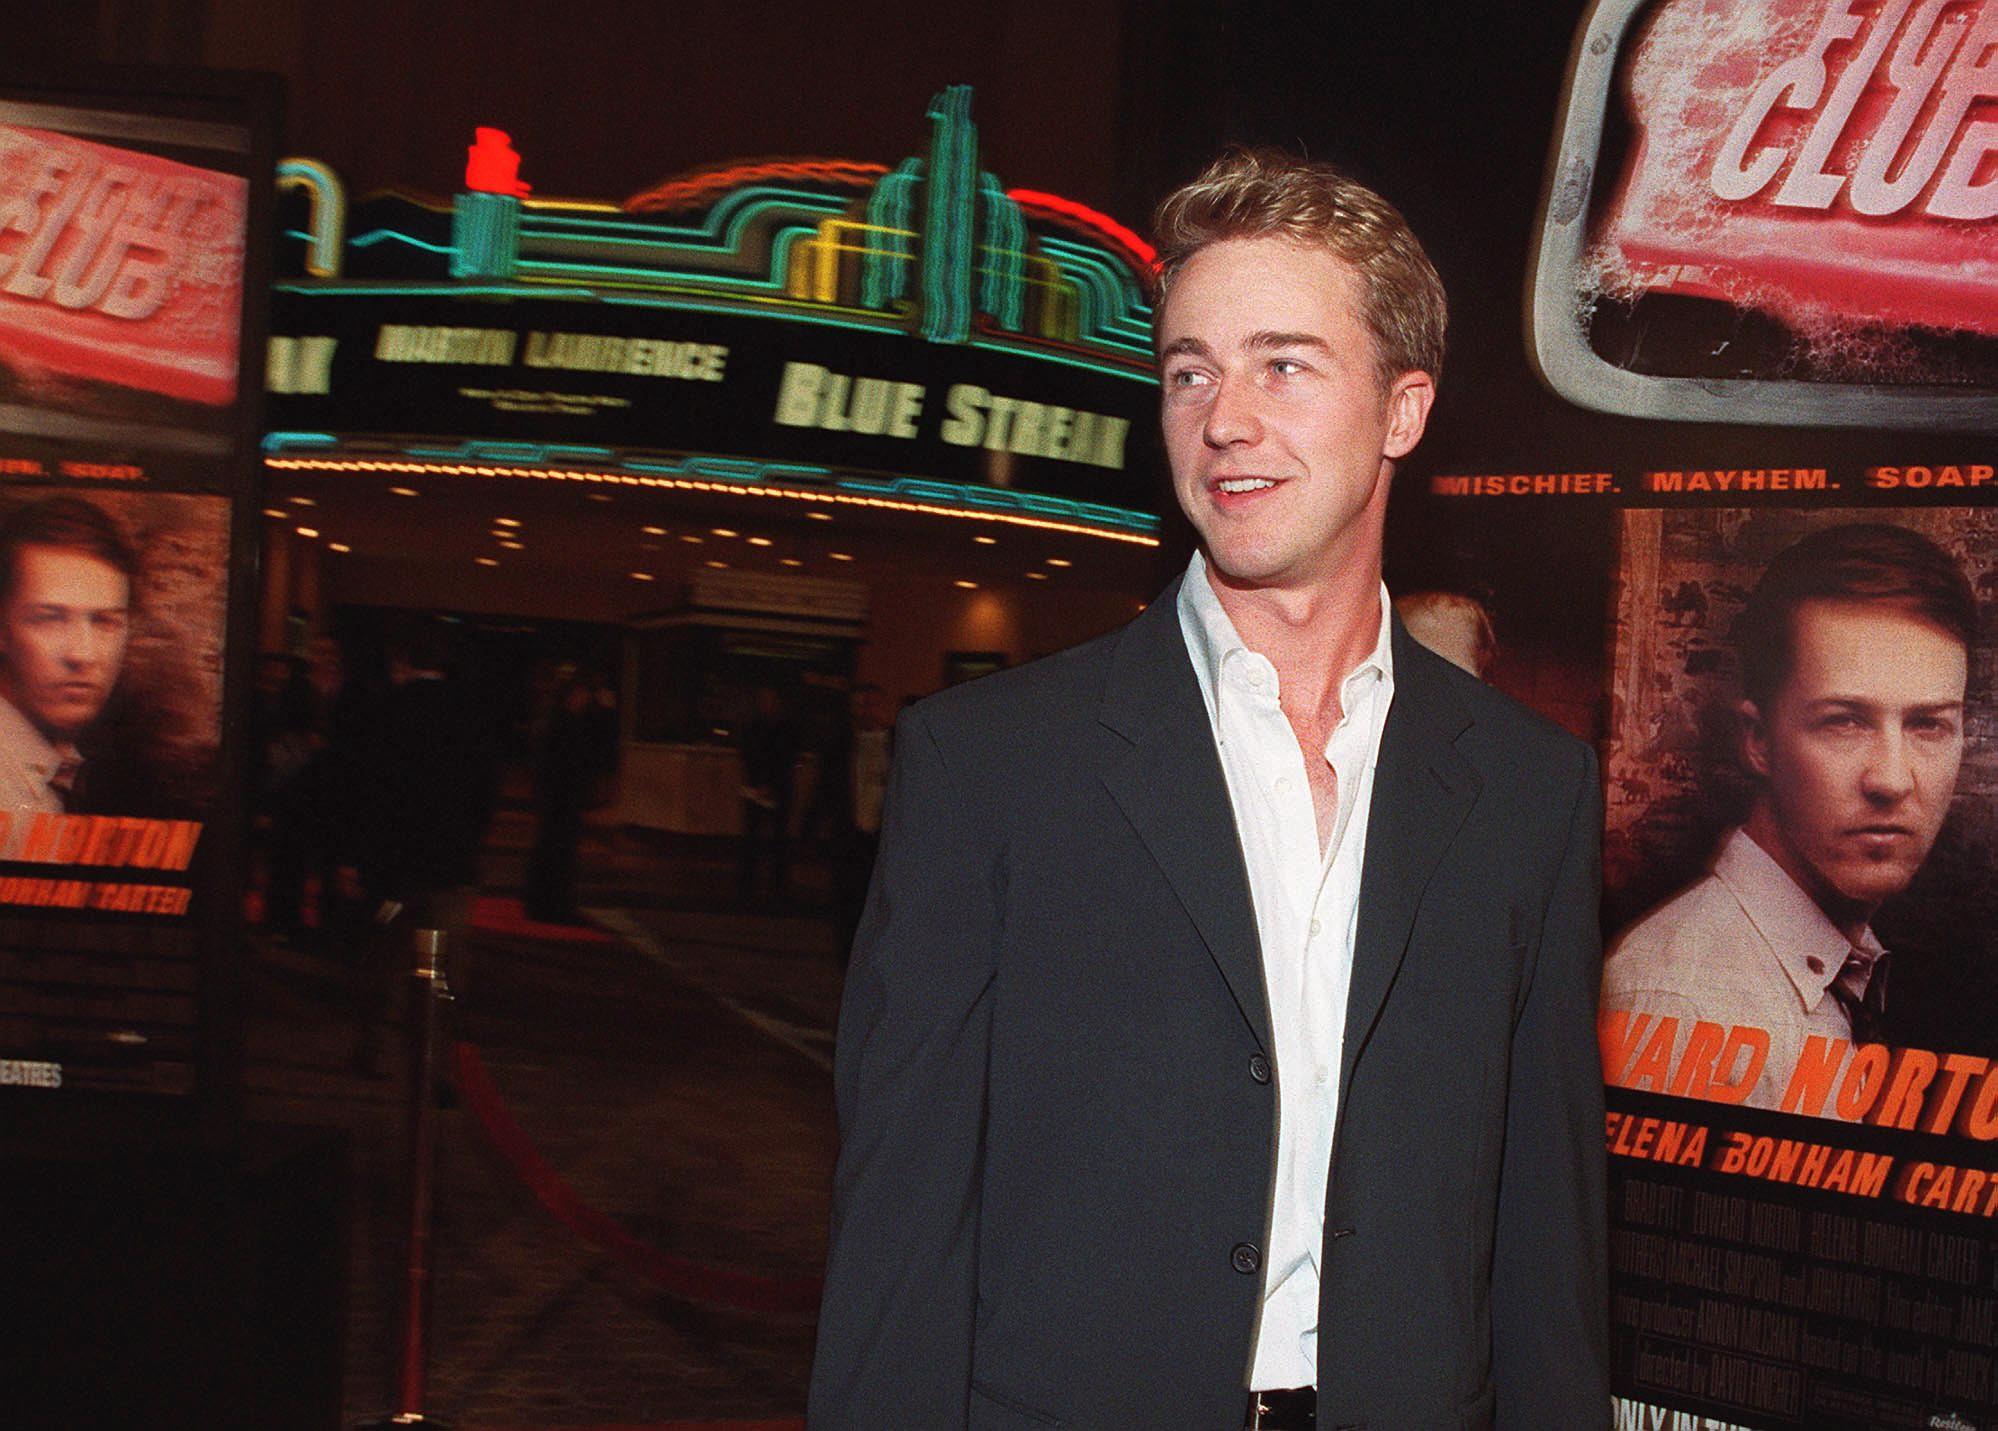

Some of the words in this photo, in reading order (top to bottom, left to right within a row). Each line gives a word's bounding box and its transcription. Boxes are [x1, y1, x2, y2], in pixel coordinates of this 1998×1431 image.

[774, 360, 927, 439] BLUE
[1434, 474, 1622, 495] MISCHIEF.
[1649, 469, 1840, 492] MAYHEM.
[1721, 1132, 1894, 1198] BONHAM
